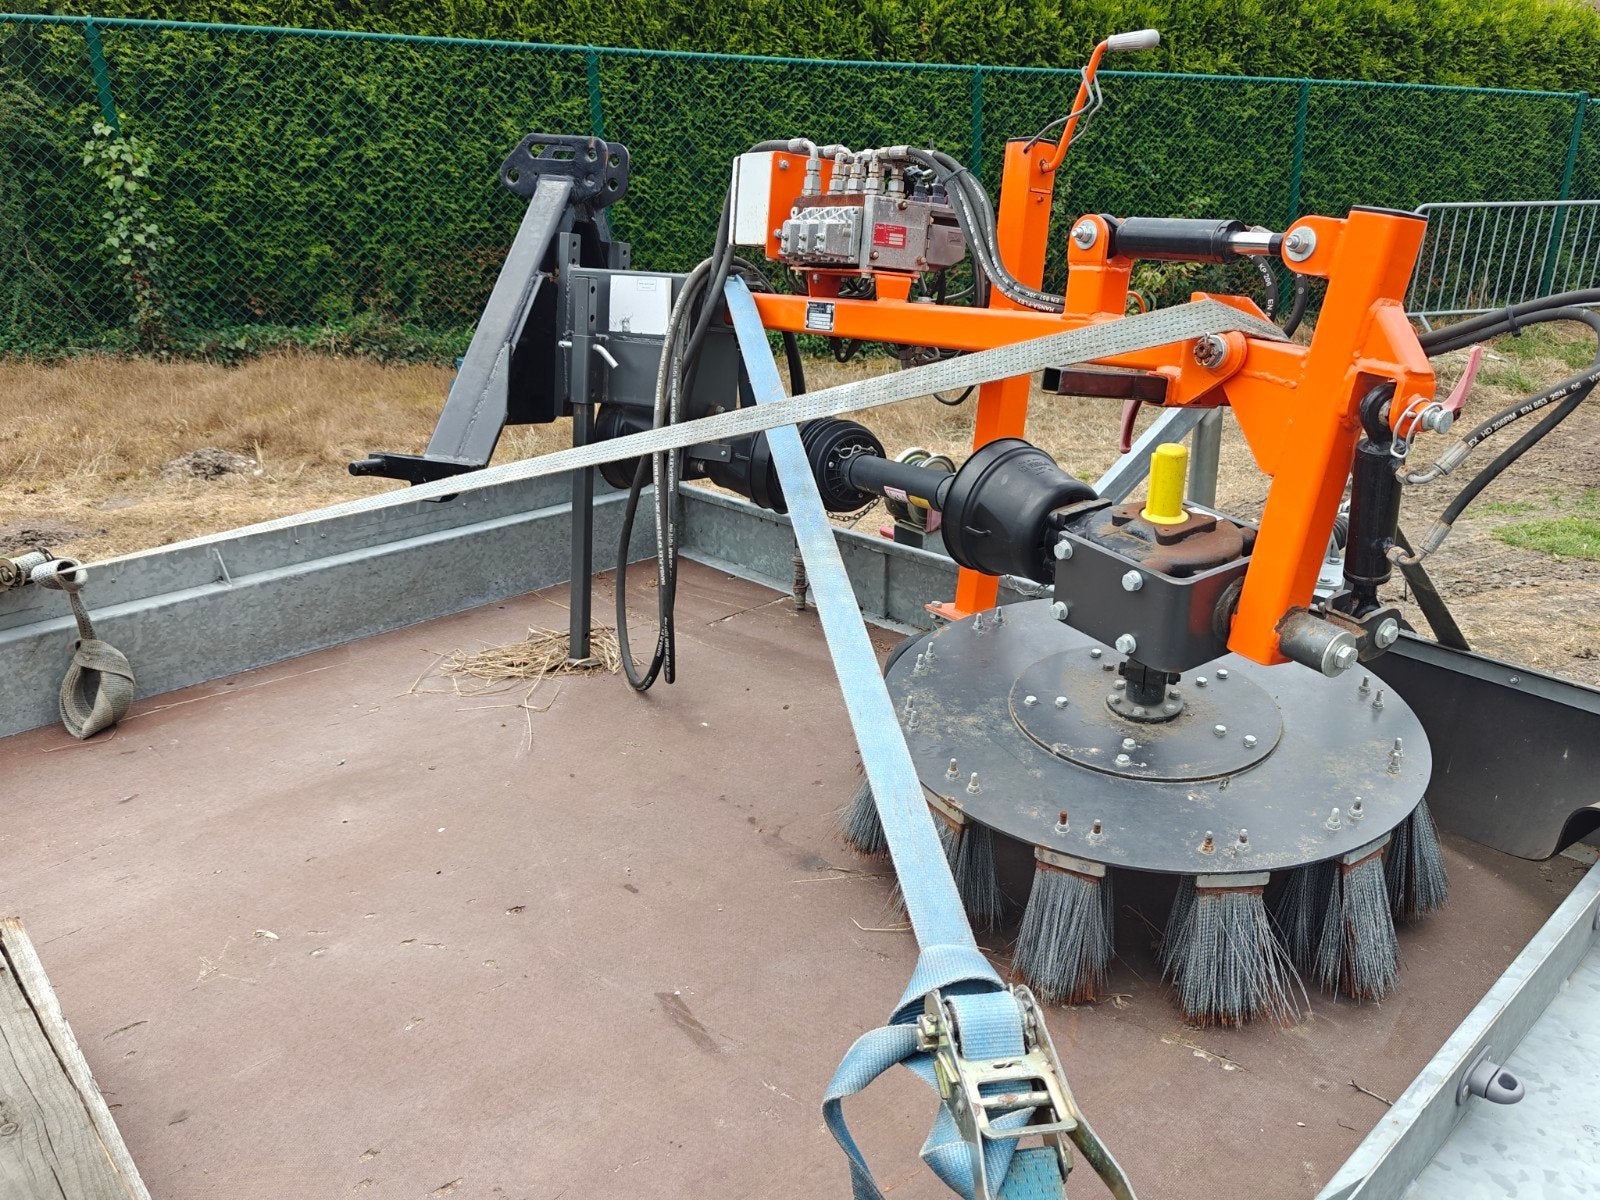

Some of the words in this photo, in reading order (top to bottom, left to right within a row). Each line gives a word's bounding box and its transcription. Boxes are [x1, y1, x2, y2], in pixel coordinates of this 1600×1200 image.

[1258, 263, 1267, 272] KP
[1267, 299, 1274, 310] EN
[1481, 428, 1493, 437] HD
[1520, 404, 1533, 414] EN
[1533, 397, 1548, 408] 853
[1550, 388, 1567, 400] 2SN
[658, 550, 666, 585] HANSA-FLEX
